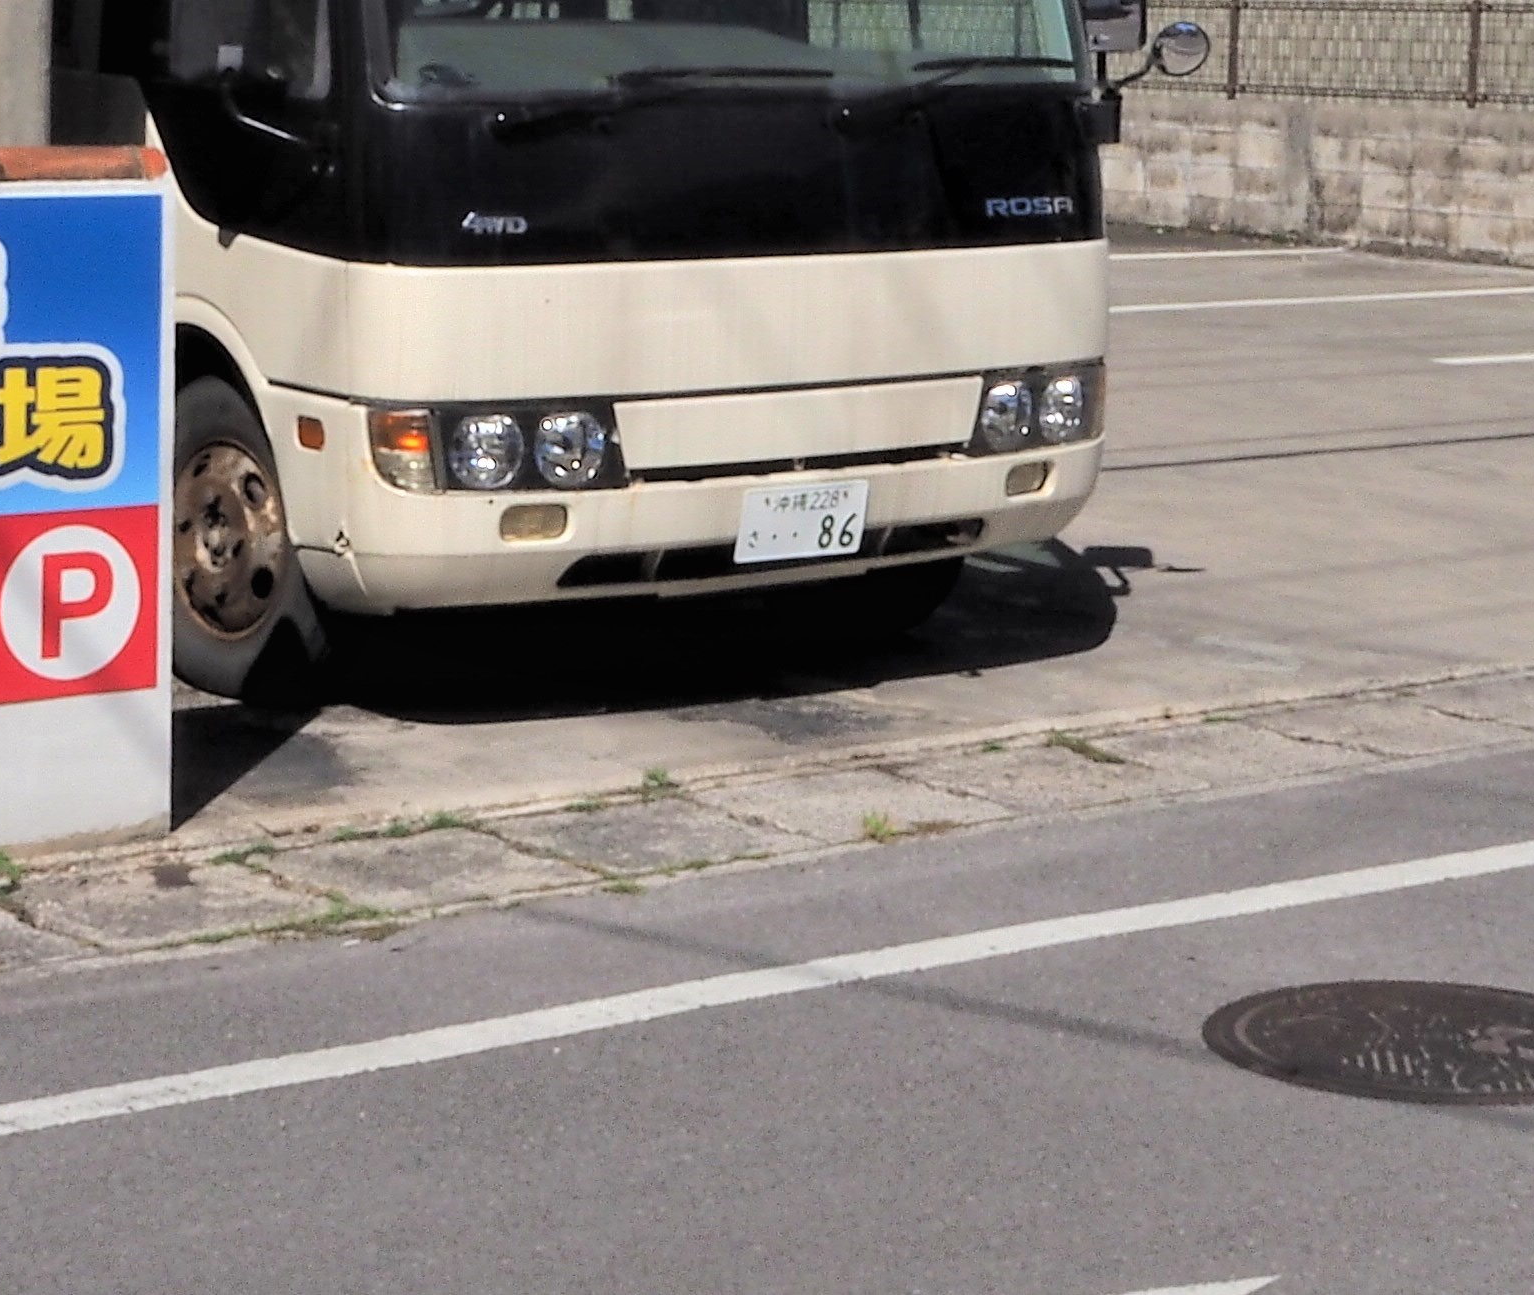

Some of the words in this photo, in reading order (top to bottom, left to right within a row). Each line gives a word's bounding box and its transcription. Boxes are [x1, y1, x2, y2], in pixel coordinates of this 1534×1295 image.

[985, 196, 1074, 218] ROSA
[461, 210, 528, 235] 4WD
[39, 550, 115, 660] P
